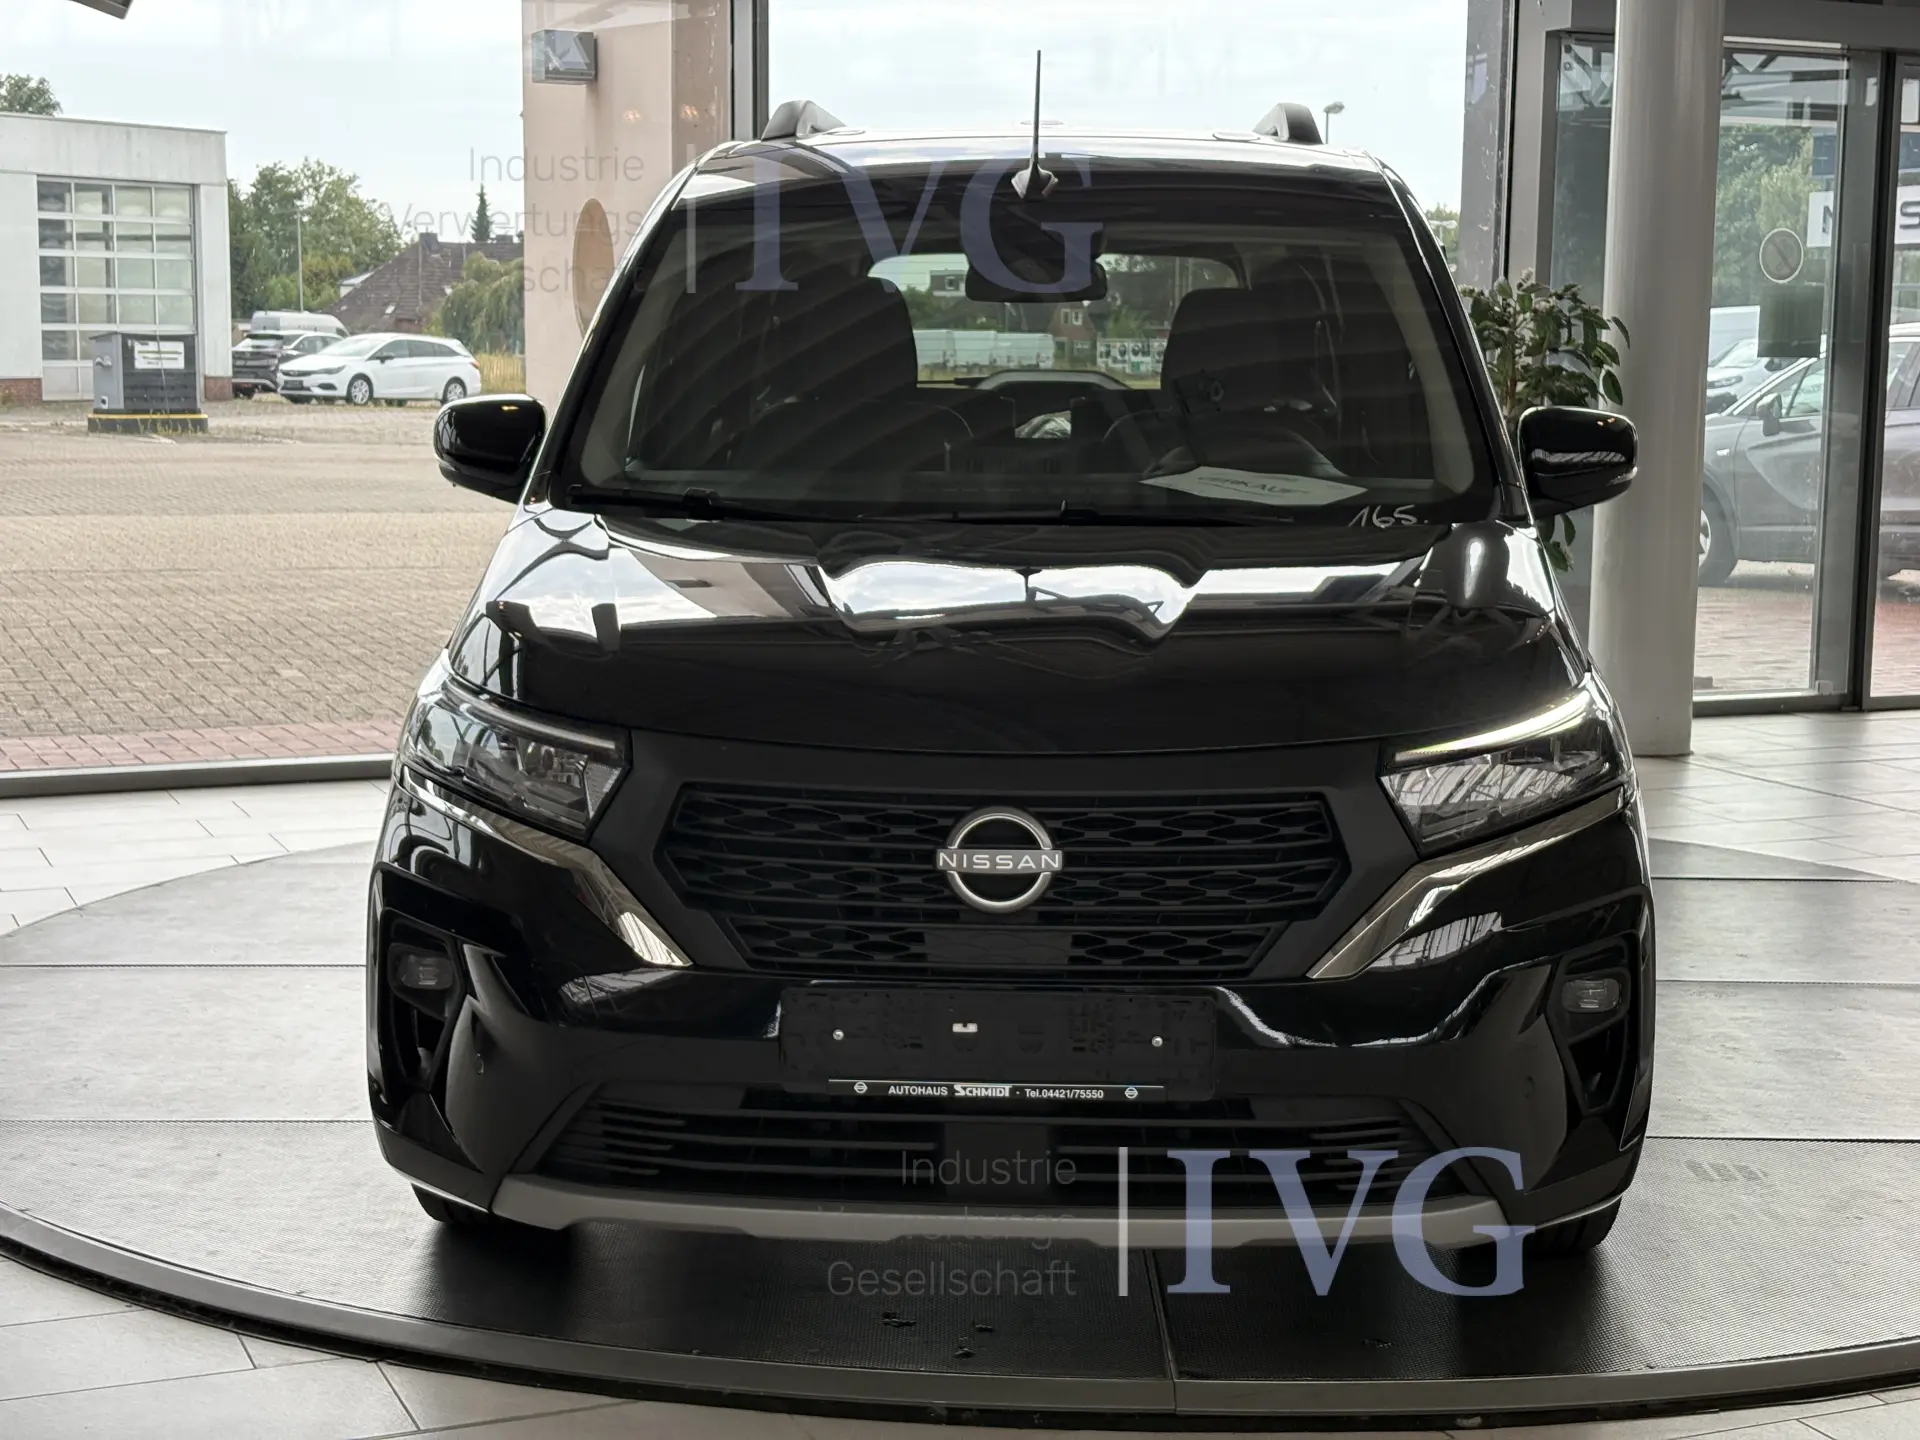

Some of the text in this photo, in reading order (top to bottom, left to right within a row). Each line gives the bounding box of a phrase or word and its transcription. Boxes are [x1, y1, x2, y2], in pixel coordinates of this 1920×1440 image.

[939, 852, 1059, 869] NISSAN
[888, 1084, 1104, 1099] AUTOHAUS SCHMIDT Tel.04421/75550
